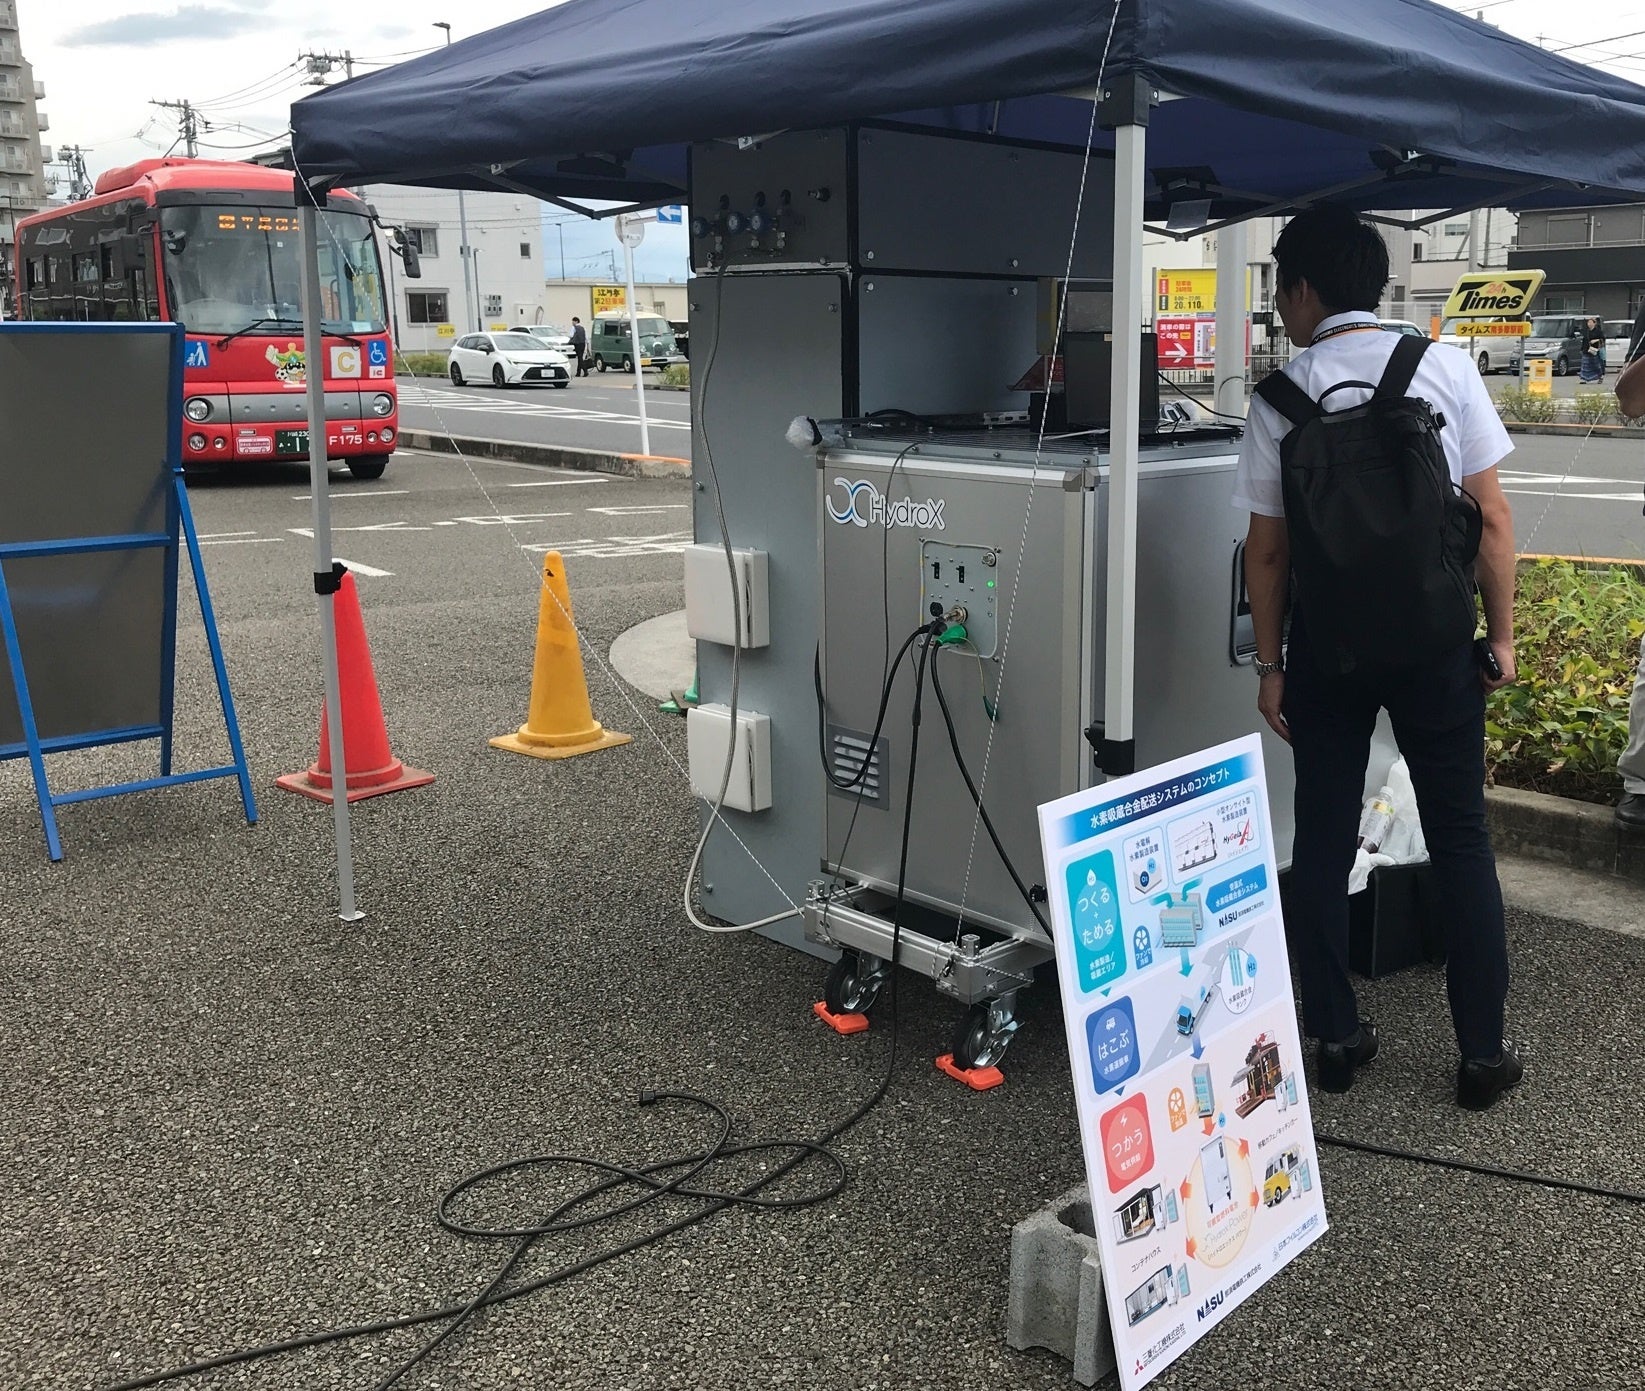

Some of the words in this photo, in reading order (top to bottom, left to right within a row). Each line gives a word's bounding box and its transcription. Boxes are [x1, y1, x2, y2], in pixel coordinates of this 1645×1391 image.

[1458, 290, 1524, 312] Times
[337, 351, 355, 373] C
[329, 434, 363, 446] F175
[869, 494, 946, 530] HydroX
[1090, 767, 1230, 829] 水素吸蔵合金配送システムのコンセプト
[1078, 887, 1110, 912] つくる
[1082, 918, 1114, 946] ためる
[1098, 1029, 1130, 1060] はこぶ
[1111, 1128, 1143, 1157] つかう
[1196, 1289, 1225, 1323] NASU
